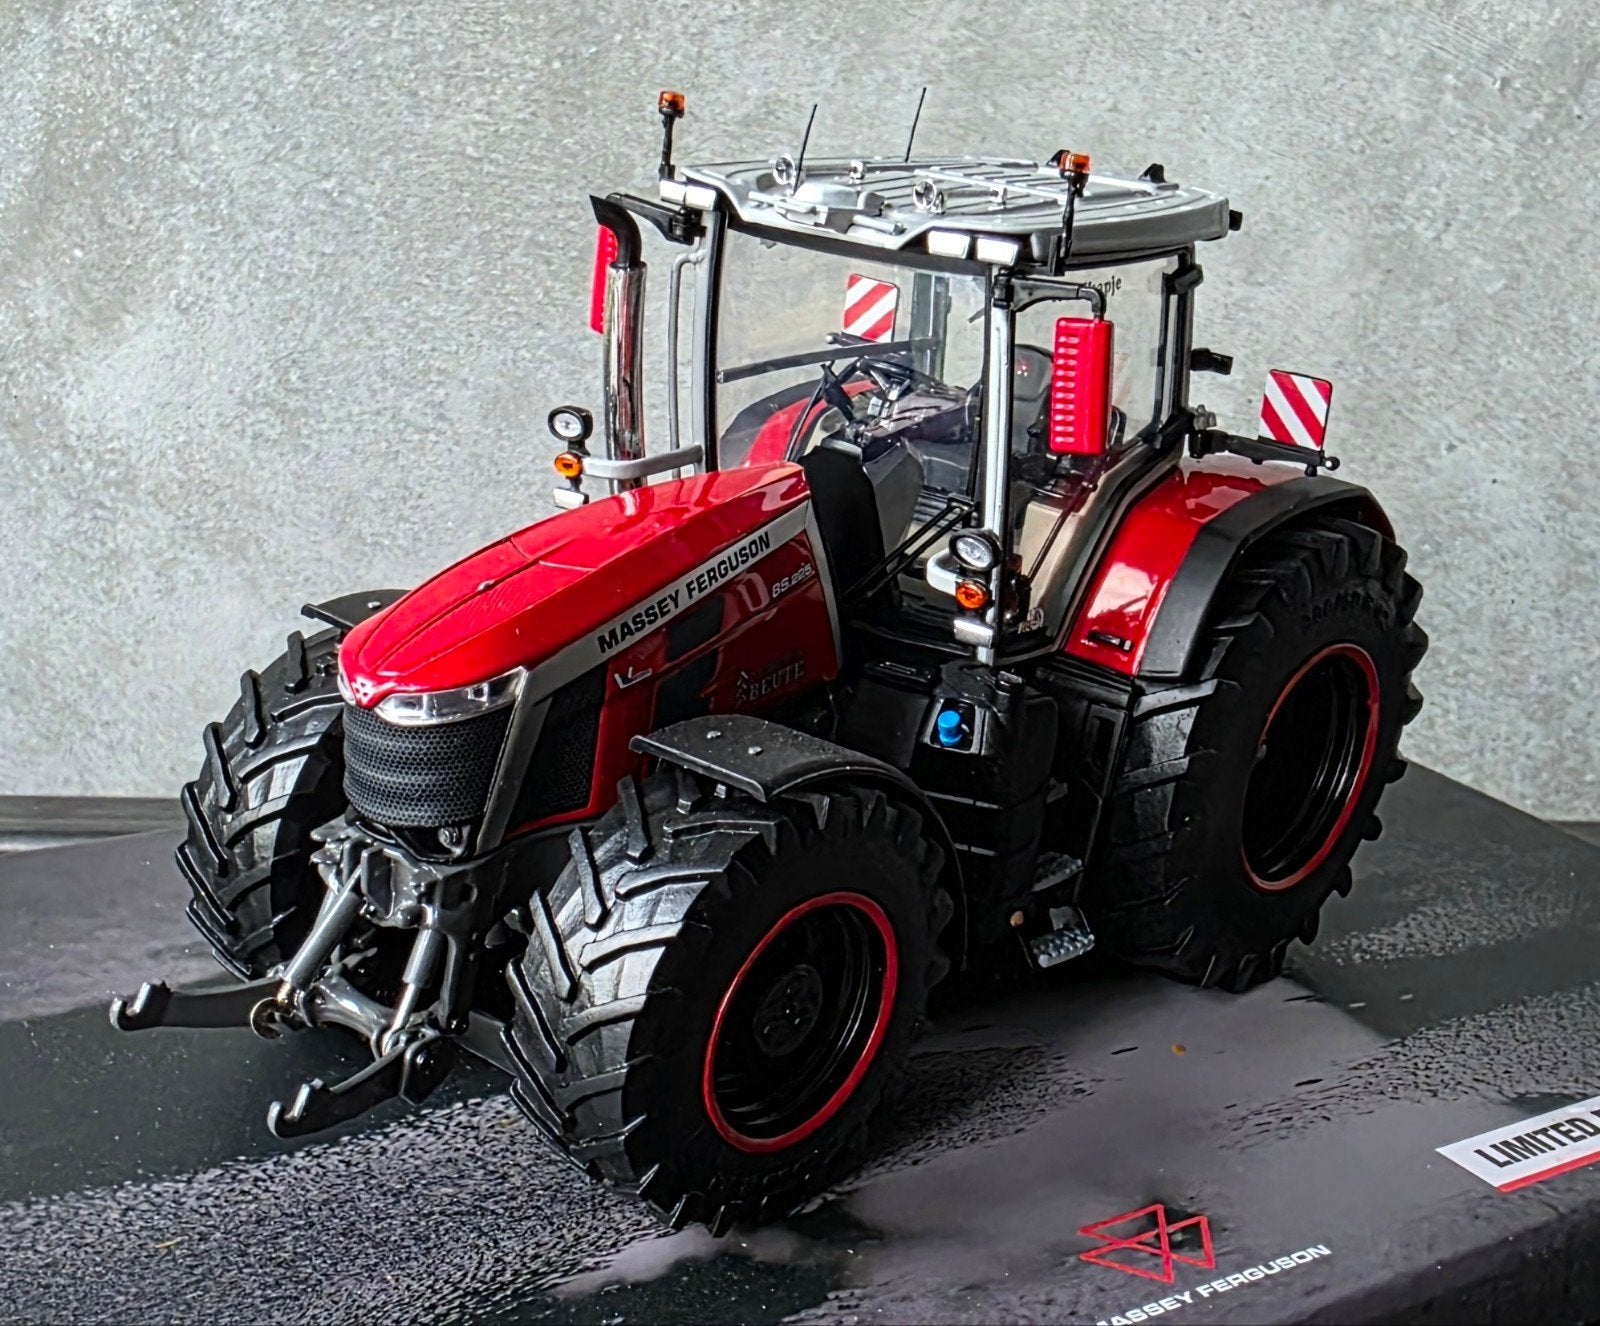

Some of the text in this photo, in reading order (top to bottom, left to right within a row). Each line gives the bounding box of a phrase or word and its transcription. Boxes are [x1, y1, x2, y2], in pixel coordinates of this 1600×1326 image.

[597, 532, 771, 653] MASSEY FERGUSON
[1474, 1117, 1600, 1168] LIMITED
[1196, 1244, 1332, 1298] FERGUSON
